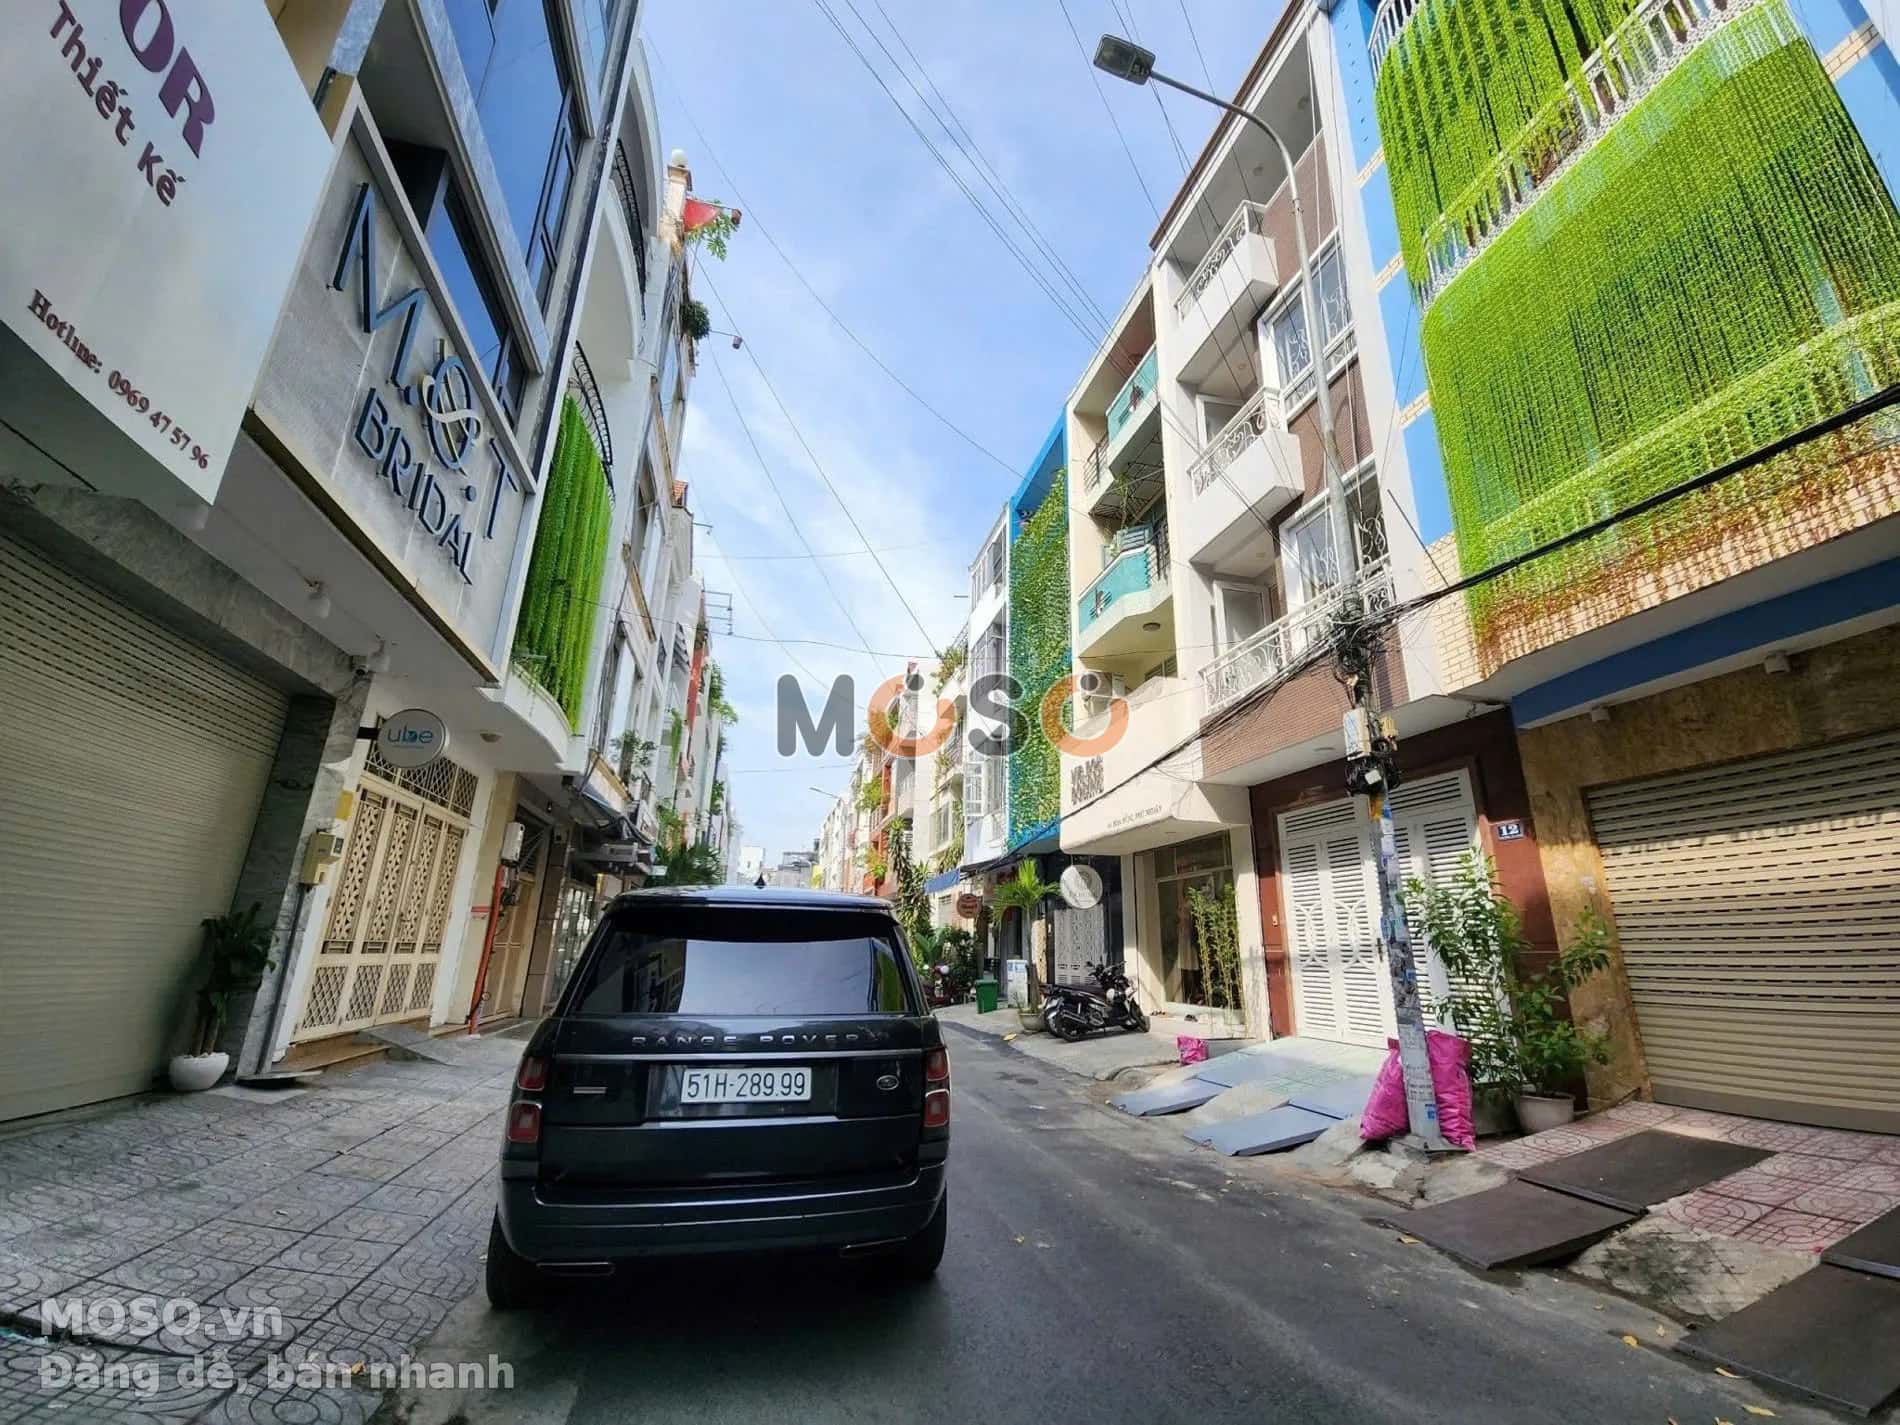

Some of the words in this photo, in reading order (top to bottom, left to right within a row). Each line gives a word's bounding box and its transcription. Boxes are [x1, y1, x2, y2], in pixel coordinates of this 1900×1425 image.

[49, 0, 136, 147] Thiết
[136, 141, 186, 207] Kế
[119, 0, 216, 160] OR
[27, 288, 103, 375] Hotline:
[108, 370, 151, 415] 0969
[149, 410, 173, 437] 47
[169, 427, 191, 453] 57
[189, 444, 210, 470] 96
[354, 387, 473, 586] BRIDAL
[1499, 824, 1520, 836] 12
[631, 1035, 738, 1047] RANGE
[759, 1033, 860, 1045] ROVER
[686, 1072, 806, 1099] 51H-289.99
